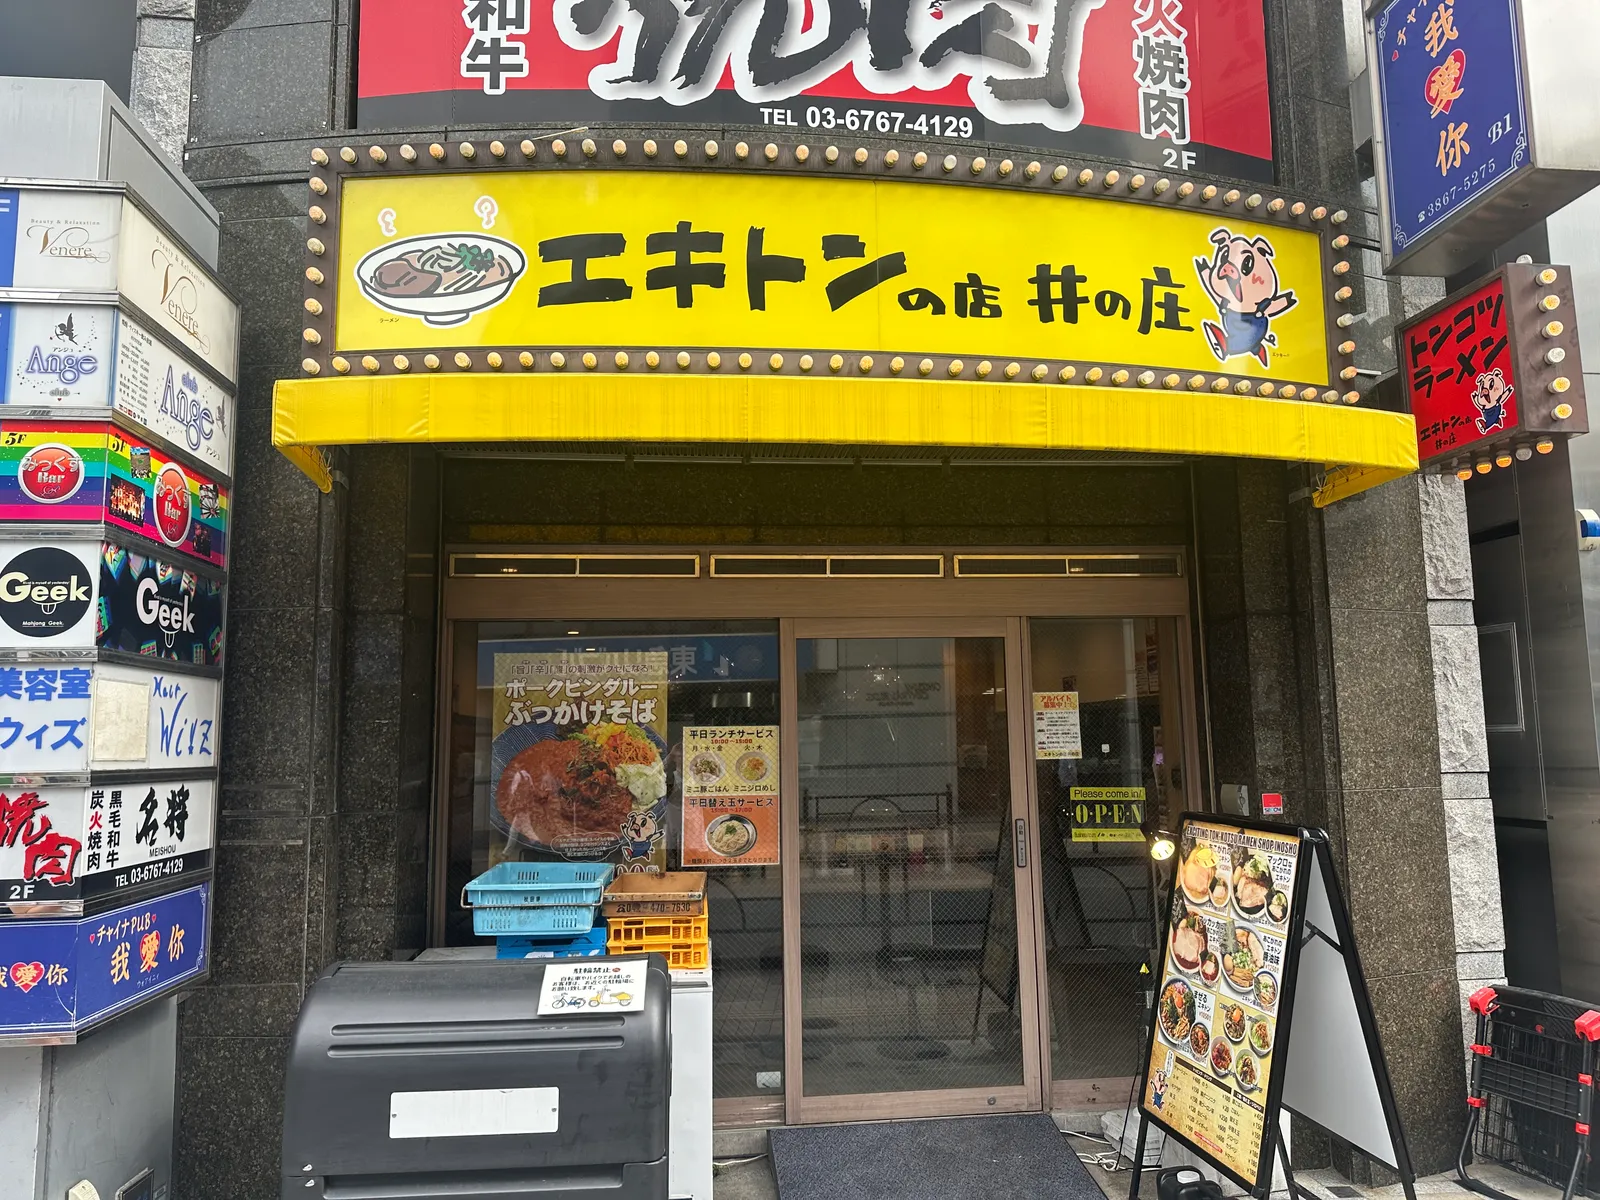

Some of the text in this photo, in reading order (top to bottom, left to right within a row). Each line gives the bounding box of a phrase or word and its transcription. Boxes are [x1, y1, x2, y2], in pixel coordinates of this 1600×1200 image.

[760, 105, 973, 138] TEL 03-6767-4129
[1487, 113, 1513, 145] B1
[1163, 151, 1196, 169] 2F
[26, 225, 111, 264] Venere
[537, 221, 1195, 335] エキトンの店 井の庄
[1410, 294, 1505, 368] トンコツ
[26, 345, 98, 384] Ange
[1413, 334, 1508, 398] ラーメン
[160, 364, 214, 450] Ange
[5, 432, 27, 446] 5F
[20, 455, 83, 473] みっくす
[37, 472, 65, 484] Bar
[164, 502, 181, 521] Bar
[0, 571, 90, 603] Geek
[136, 577, 195, 633] Geek
[0, 667, 91, 701] 美容室
[504, 677, 658, 699] ポークビンダルー
[503, 698, 658, 726] ぶっかけそば
[0, 717, 87, 750] ウィズ
[689, 729, 774, 739] 平日ランチサービス
[689, 798, 774, 808] 平日替え玉サービス
[1074, 789, 1103, 798] Please
[1105, 790, 1129, 798] come
[87, 790, 104, 871] 炭火焼肉
[106, 790, 122, 868] 黒毛和牛
[135, 784, 190, 847] 名将
[149, 845, 177, 857] MEISHOU
[1186, 826, 1208, 838] EXCITING
[1238, 835, 1257, 847] RAMEN
[1257, 837, 1274, 850] SHOP
[1274, 841, 1297, 855] INOSHO
[115, 858, 184, 887] TEL 03-6767-4129
[9, 885, 35, 900] 2F
[110, 923, 185, 985] 我愛你
